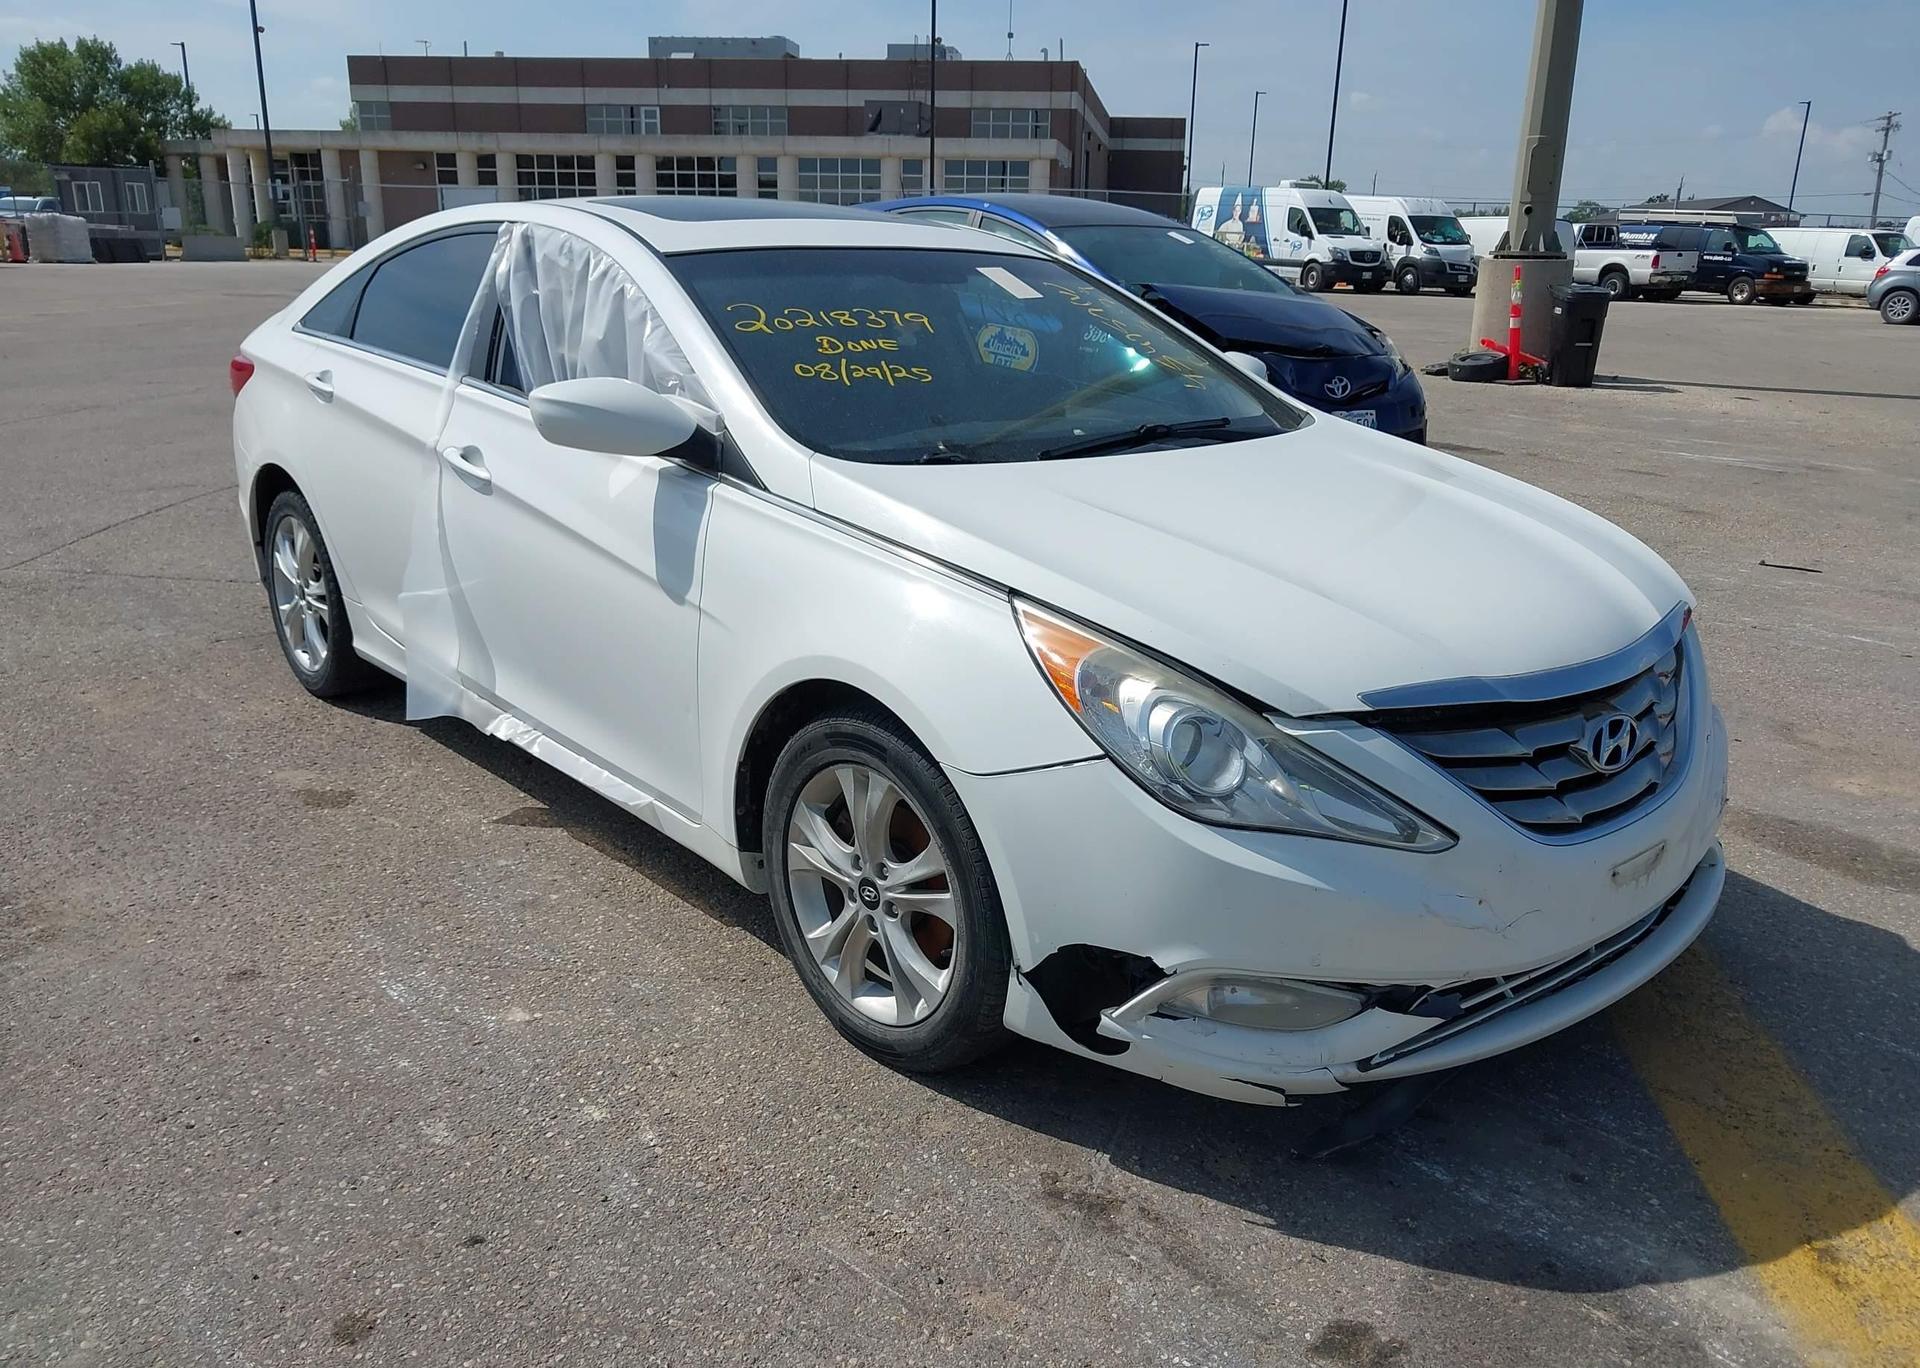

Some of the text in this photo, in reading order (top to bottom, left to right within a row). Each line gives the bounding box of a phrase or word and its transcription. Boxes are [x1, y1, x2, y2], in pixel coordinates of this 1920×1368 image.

[726, 303, 935, 335] 20218379
[815, 335, 900, 355] DONE
[989, 338, 1024, 355] Unicity
[794, 358, 933, 387] 08/29/25
